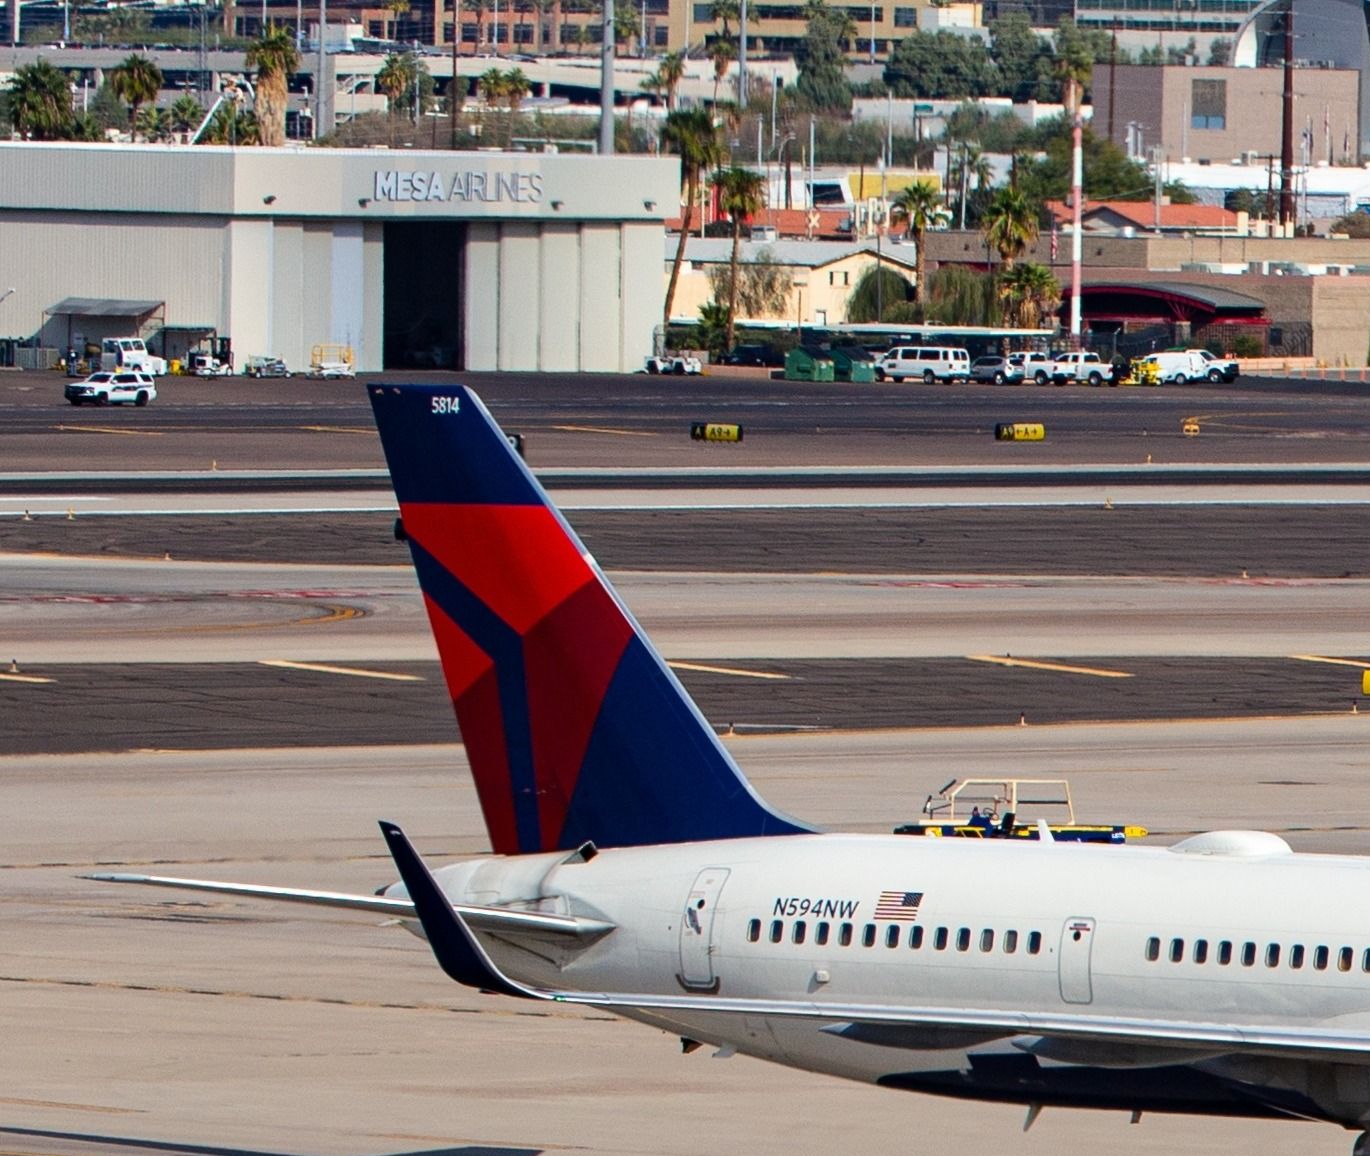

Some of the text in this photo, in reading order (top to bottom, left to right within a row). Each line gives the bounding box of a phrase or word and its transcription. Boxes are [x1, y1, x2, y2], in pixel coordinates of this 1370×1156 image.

[373, 171, 544, 202] MESA AIRLINES
[431, 396, 460, 414] 5814
[773, 897, 859, 919] N594NW
